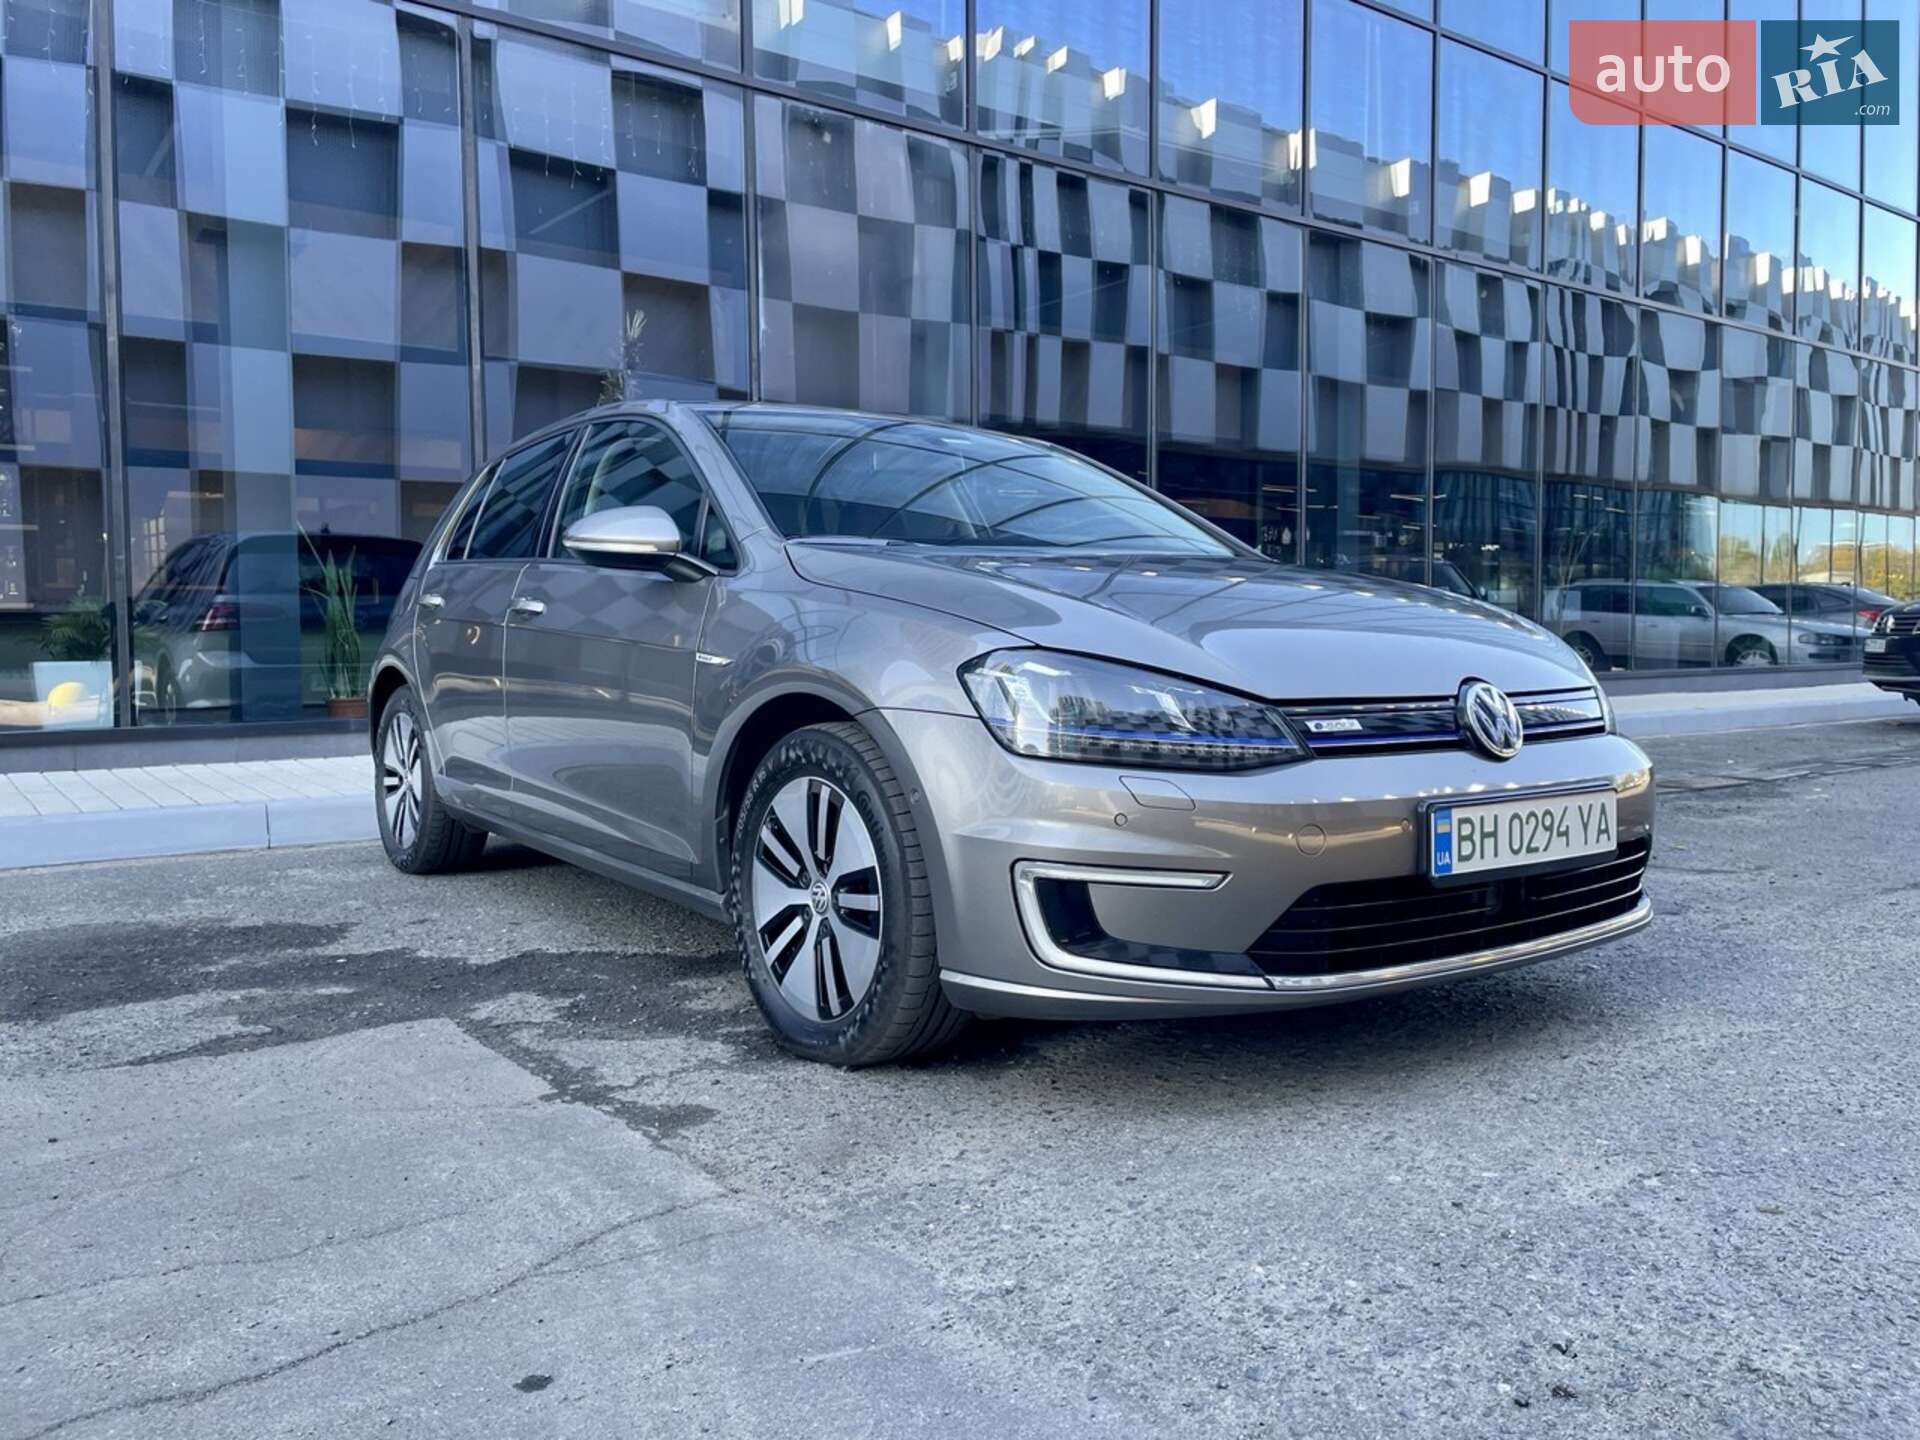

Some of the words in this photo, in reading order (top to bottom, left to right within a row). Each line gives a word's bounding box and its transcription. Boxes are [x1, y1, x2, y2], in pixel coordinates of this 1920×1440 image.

[1457, 814, 1498, 863] BH
[1508, 805, 1571, 855] 0294
[1578, 802, 1611, 846] YA
[1437, 853, 1451, 866] UA
